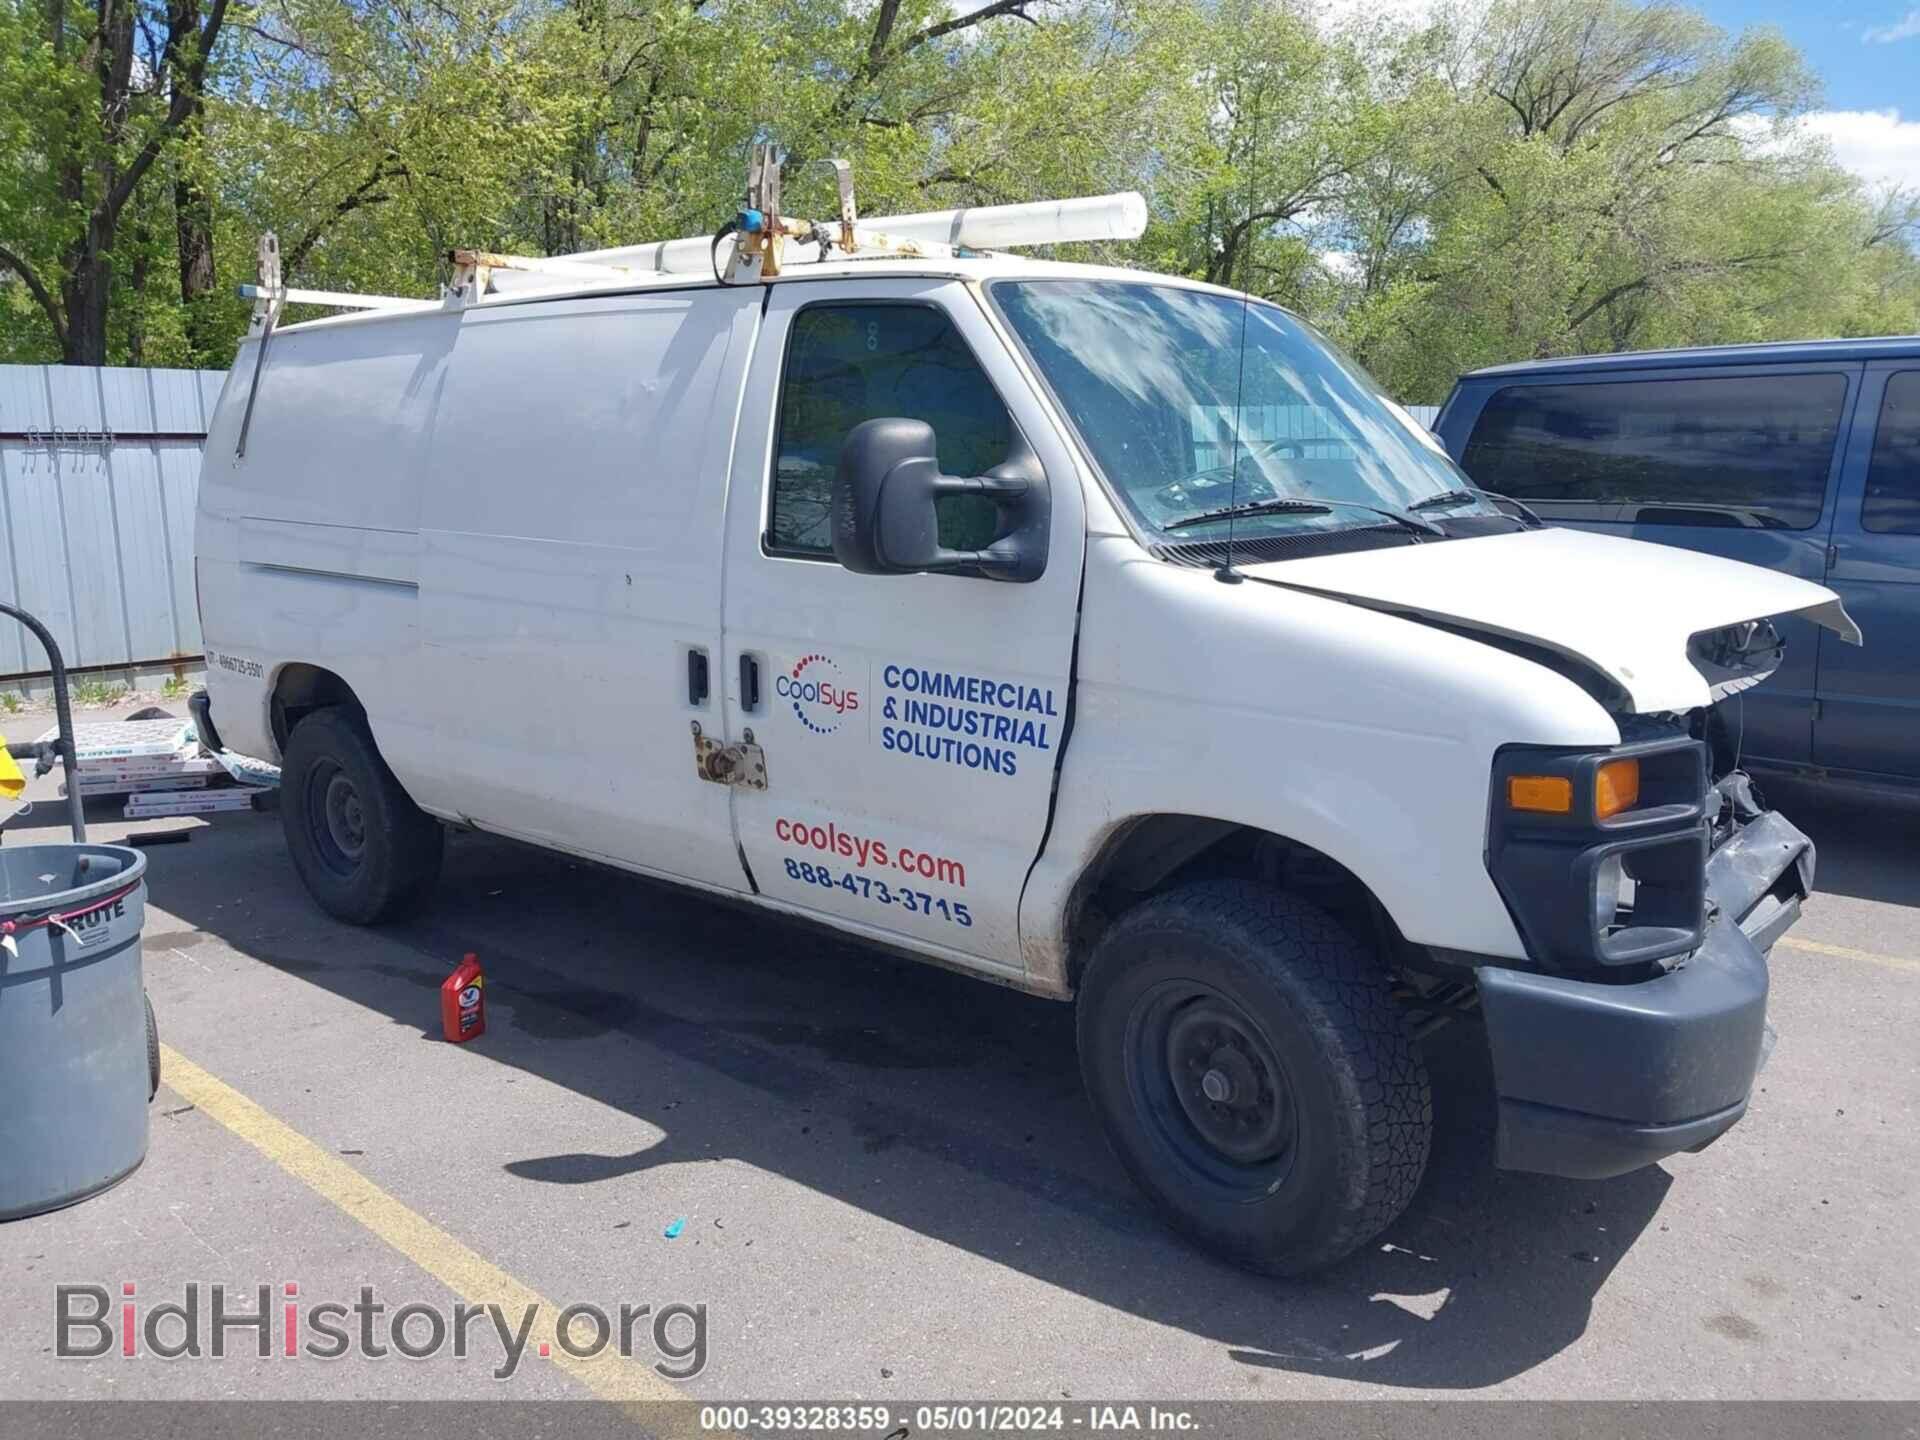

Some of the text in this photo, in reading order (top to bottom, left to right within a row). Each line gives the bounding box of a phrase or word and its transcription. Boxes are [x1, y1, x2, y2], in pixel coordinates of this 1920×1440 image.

[776, 675, 859, 714] CoolSys
[883, 664, 1058, 717] COMMERCIAL
[883, 696, 1050, 750] & INDUSTRIAL
[882, 726, 1017, 776] SOLUTIONS
[775, 818, 966, 888] coolsys.com
[784, 857, 973, 927] 888-473-3715
